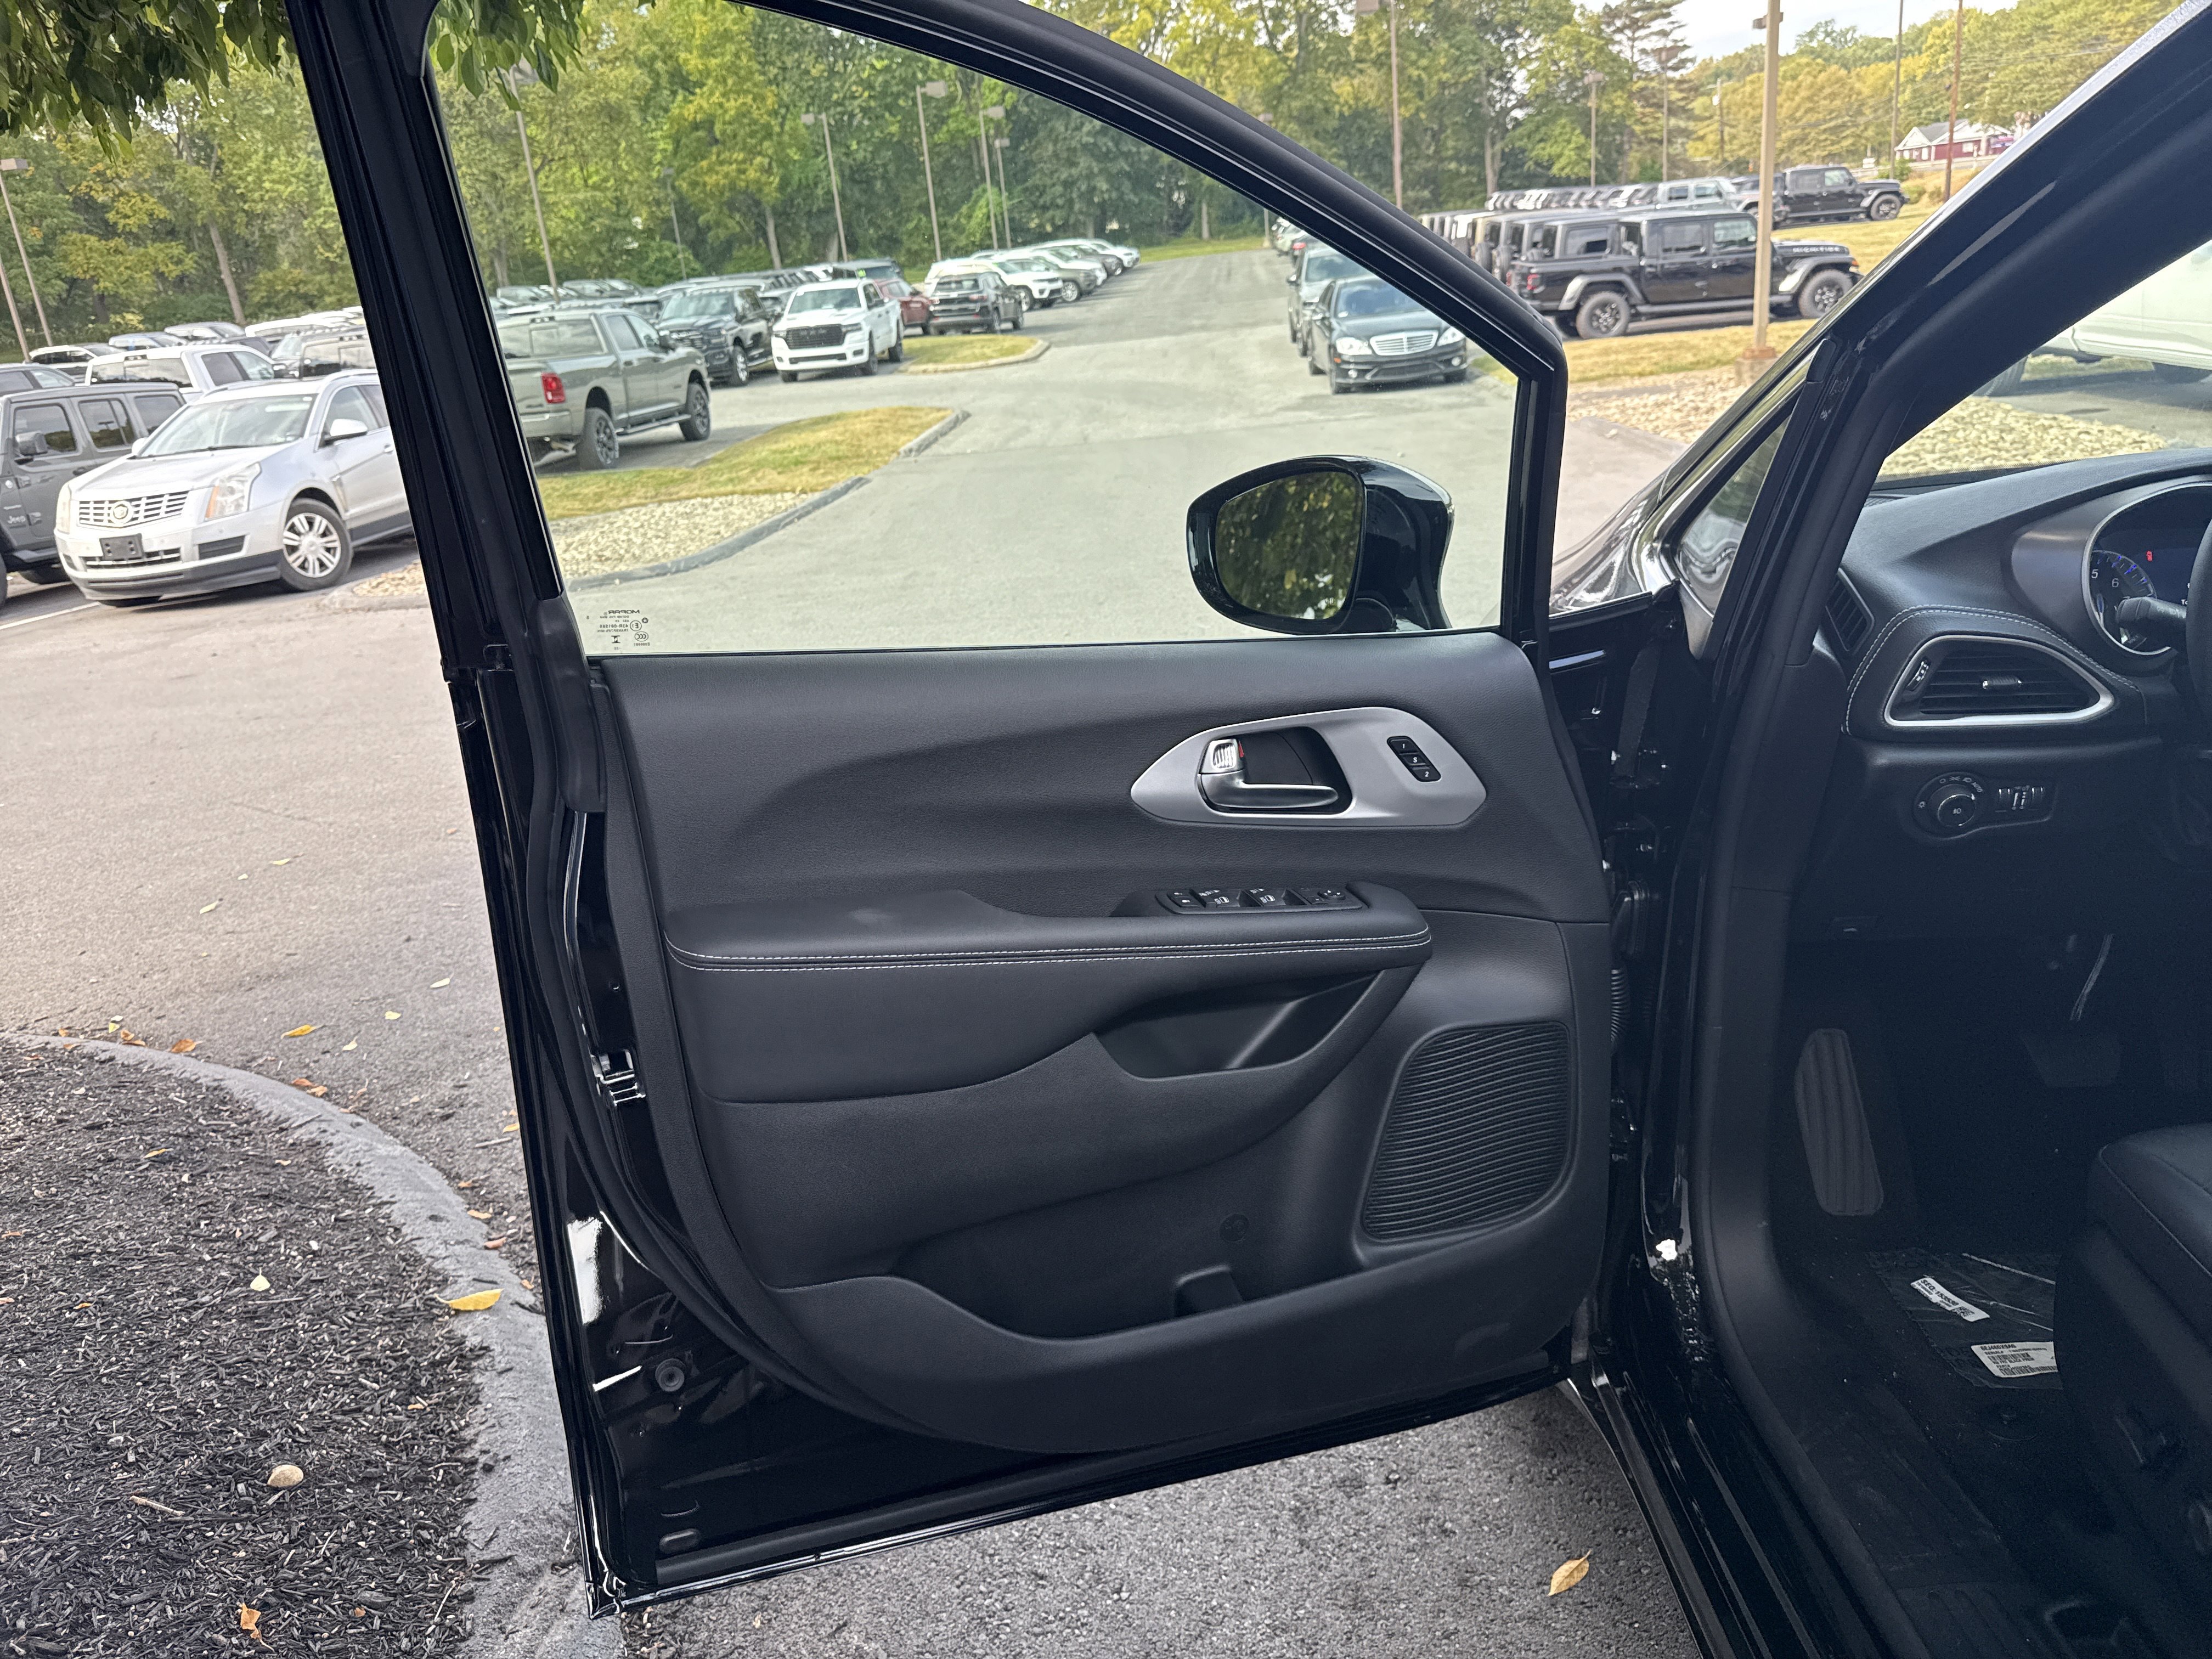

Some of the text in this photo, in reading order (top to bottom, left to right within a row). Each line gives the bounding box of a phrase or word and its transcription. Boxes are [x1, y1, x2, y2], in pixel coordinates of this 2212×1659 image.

[7, 516, 26, 524] Jeep
[2091, 568, 2099, 579] 5
[2112, 578, 2119, 588] 6
[1971, 782, 1983, 793] AUTO
